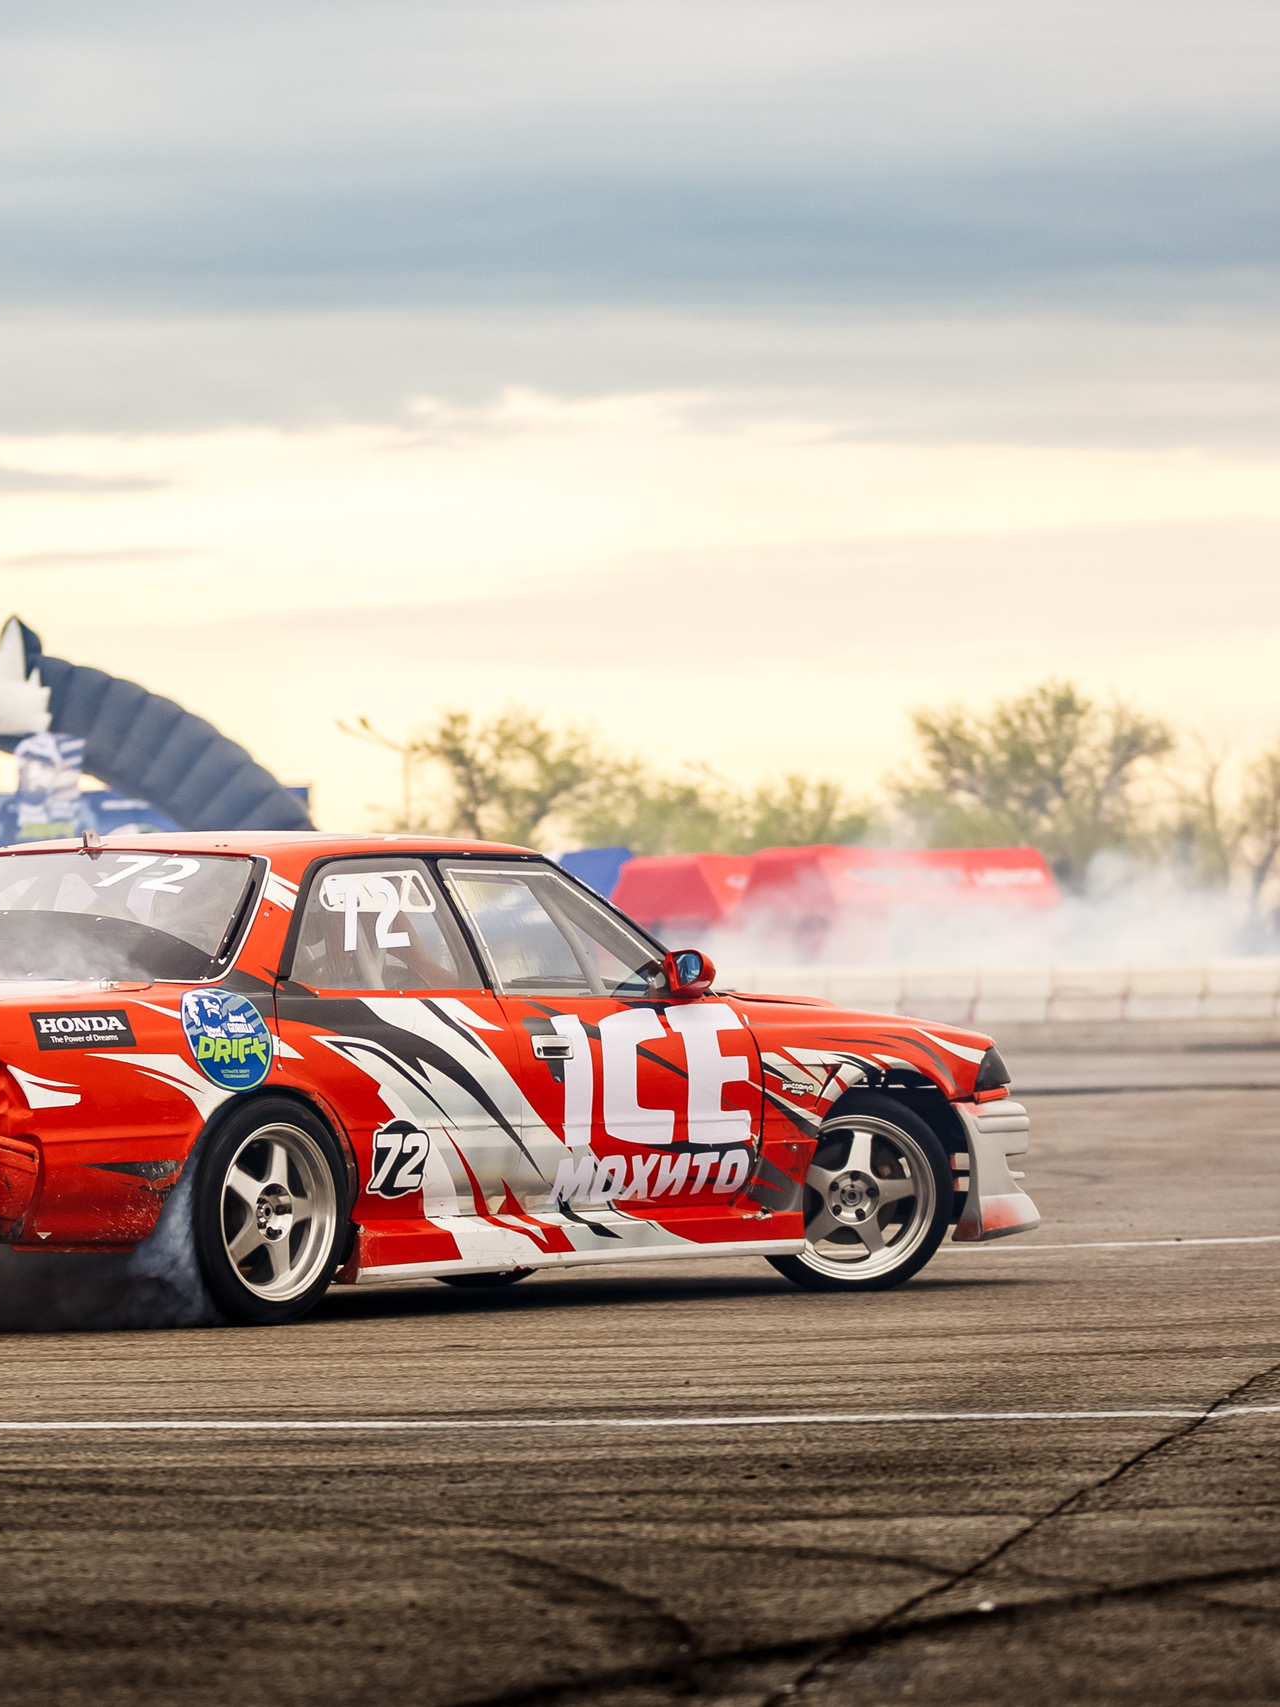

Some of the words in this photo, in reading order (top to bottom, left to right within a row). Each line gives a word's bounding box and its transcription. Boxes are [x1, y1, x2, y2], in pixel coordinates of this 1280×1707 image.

[93, 855, 200, 894] 72
[324, 876, 411, 951] 72
[37, 1016, 127, 1033] HONDA
[50, 1036, 64, 1044] The
[64, 1035, 85, 1043] Power
[85, 1034, 93, 1042] of
[197, 1035, 267, 1065] DRIFT
[550, 1003, 752, 1147] ICE
[370, 1133, 429, 1188] 72
[546, 1149, 750, 1204] МОХИТО
